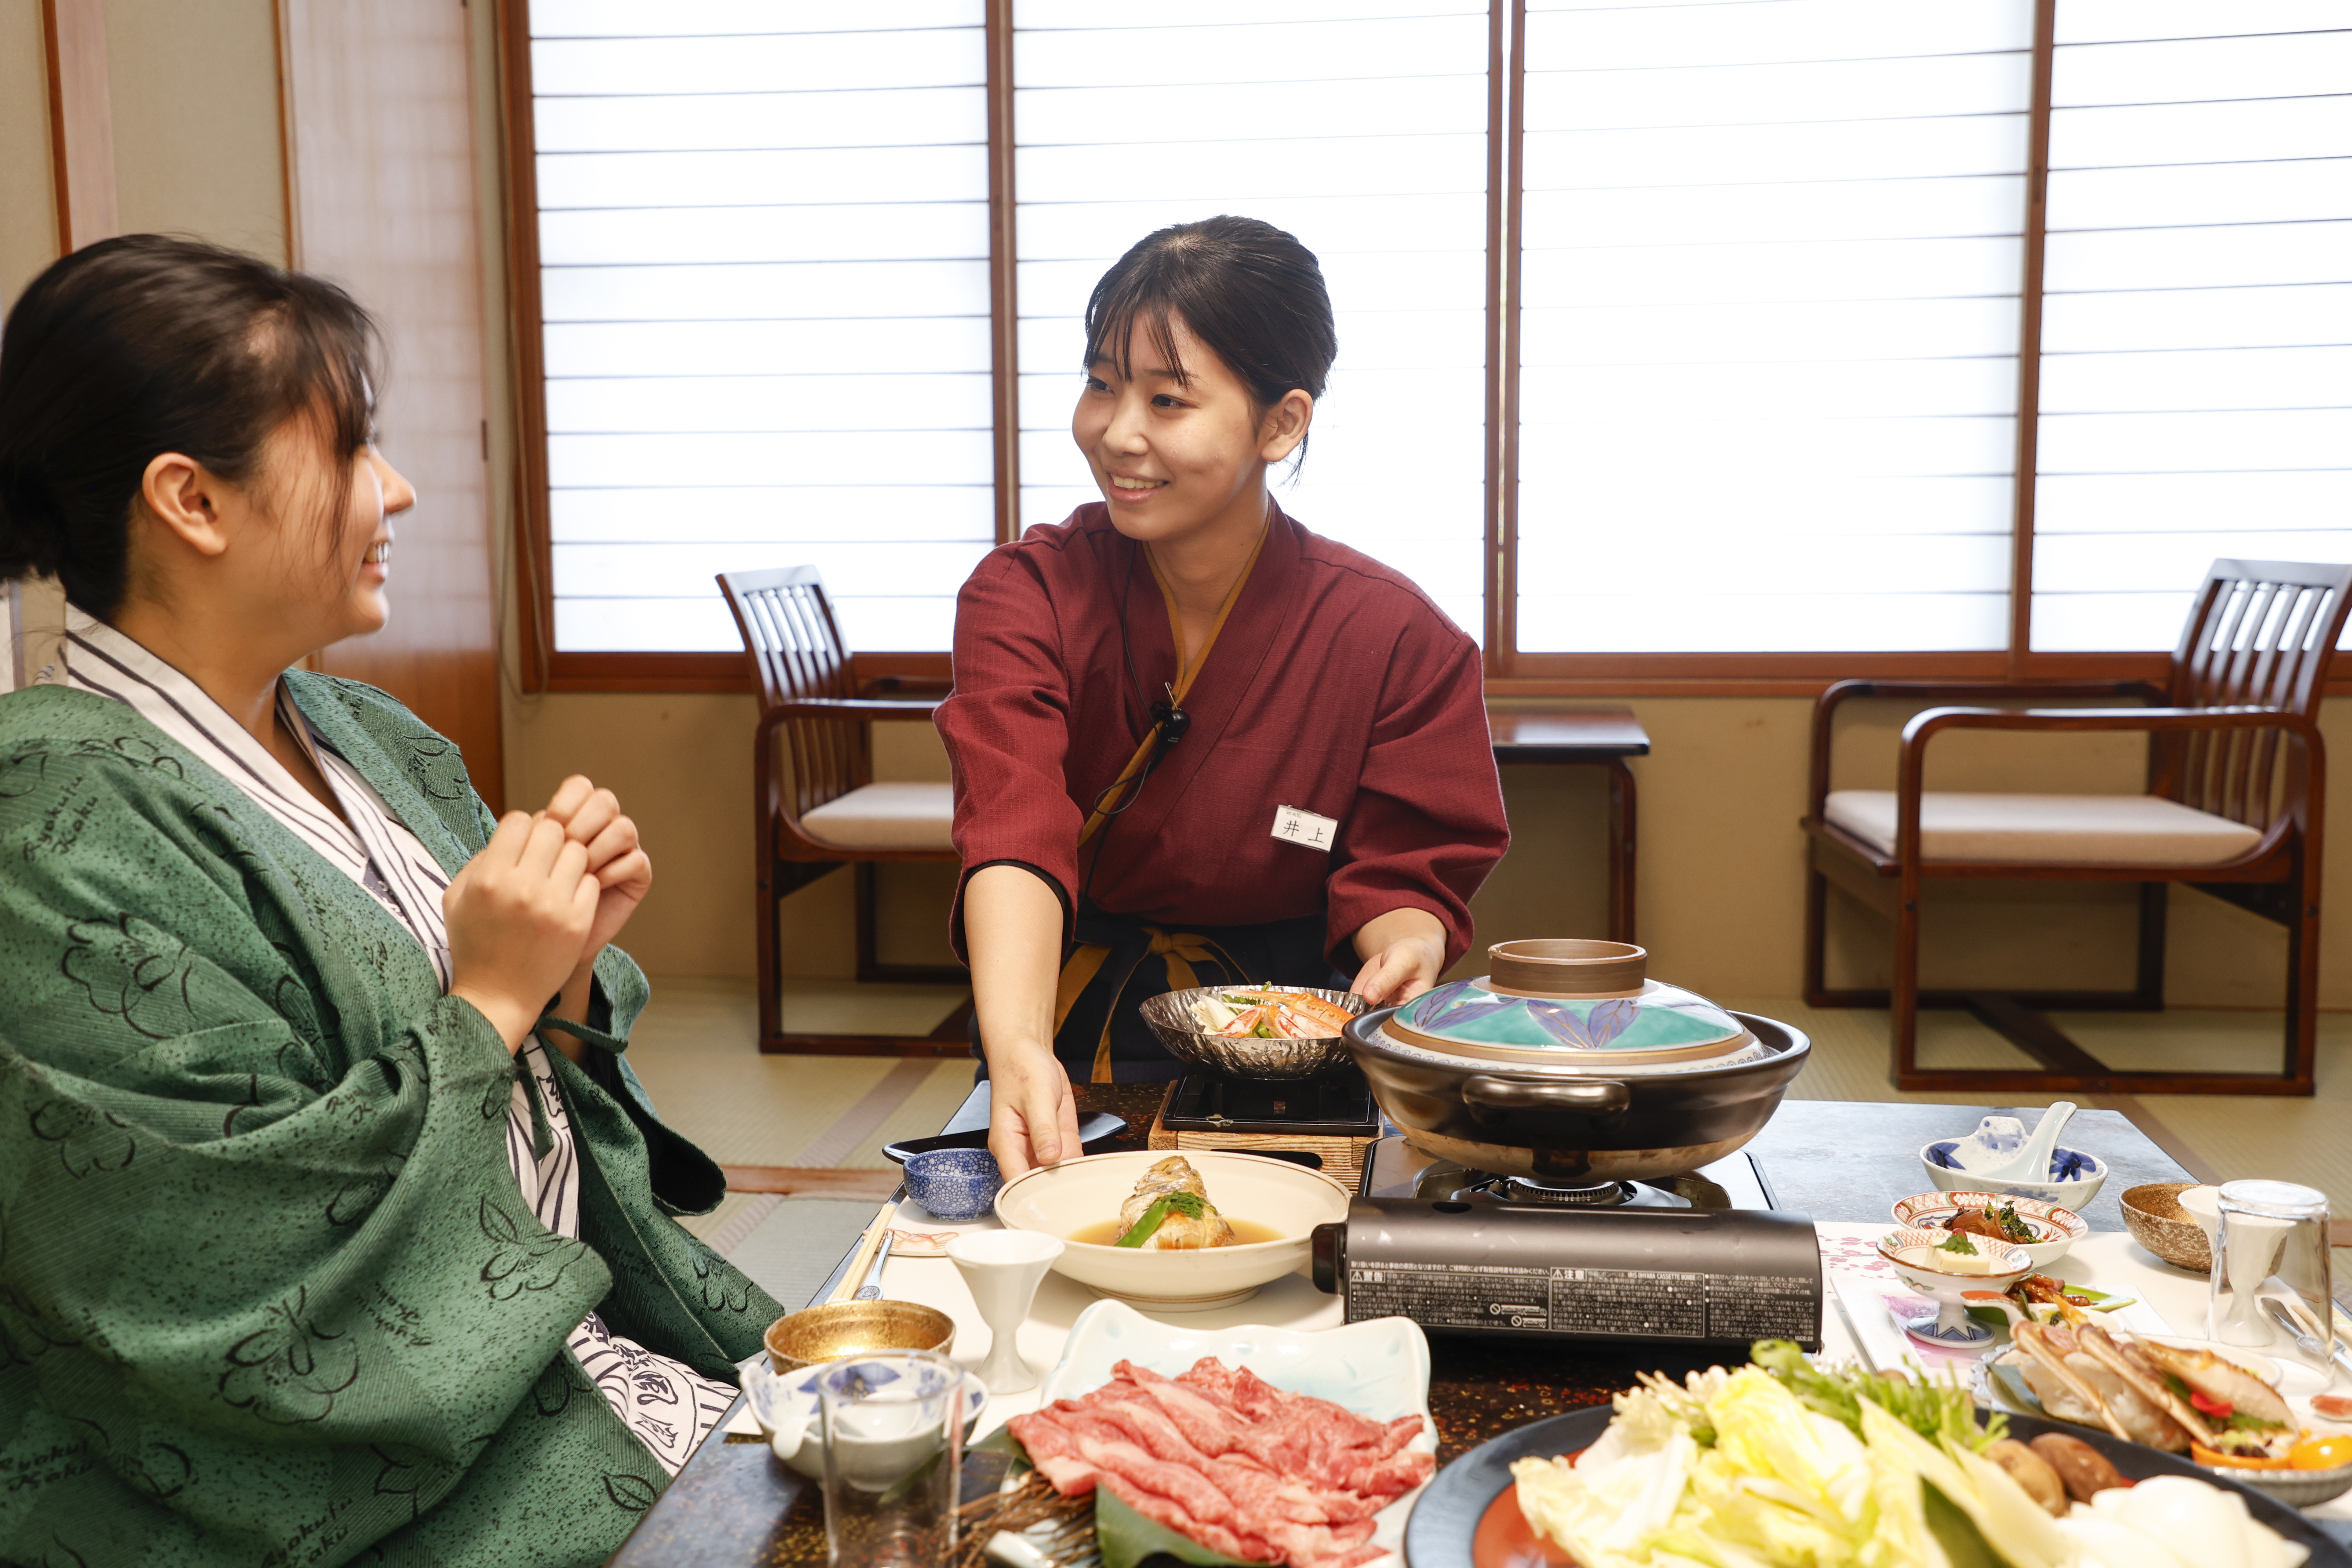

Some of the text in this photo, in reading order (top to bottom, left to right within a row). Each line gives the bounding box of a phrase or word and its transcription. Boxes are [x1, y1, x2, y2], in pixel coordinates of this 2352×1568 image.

[1283, 820, 1324, 843] 井上
[1363, 1270, 1383, 1282] 警告
[1564, 1269, 1585, 1280] 注意
